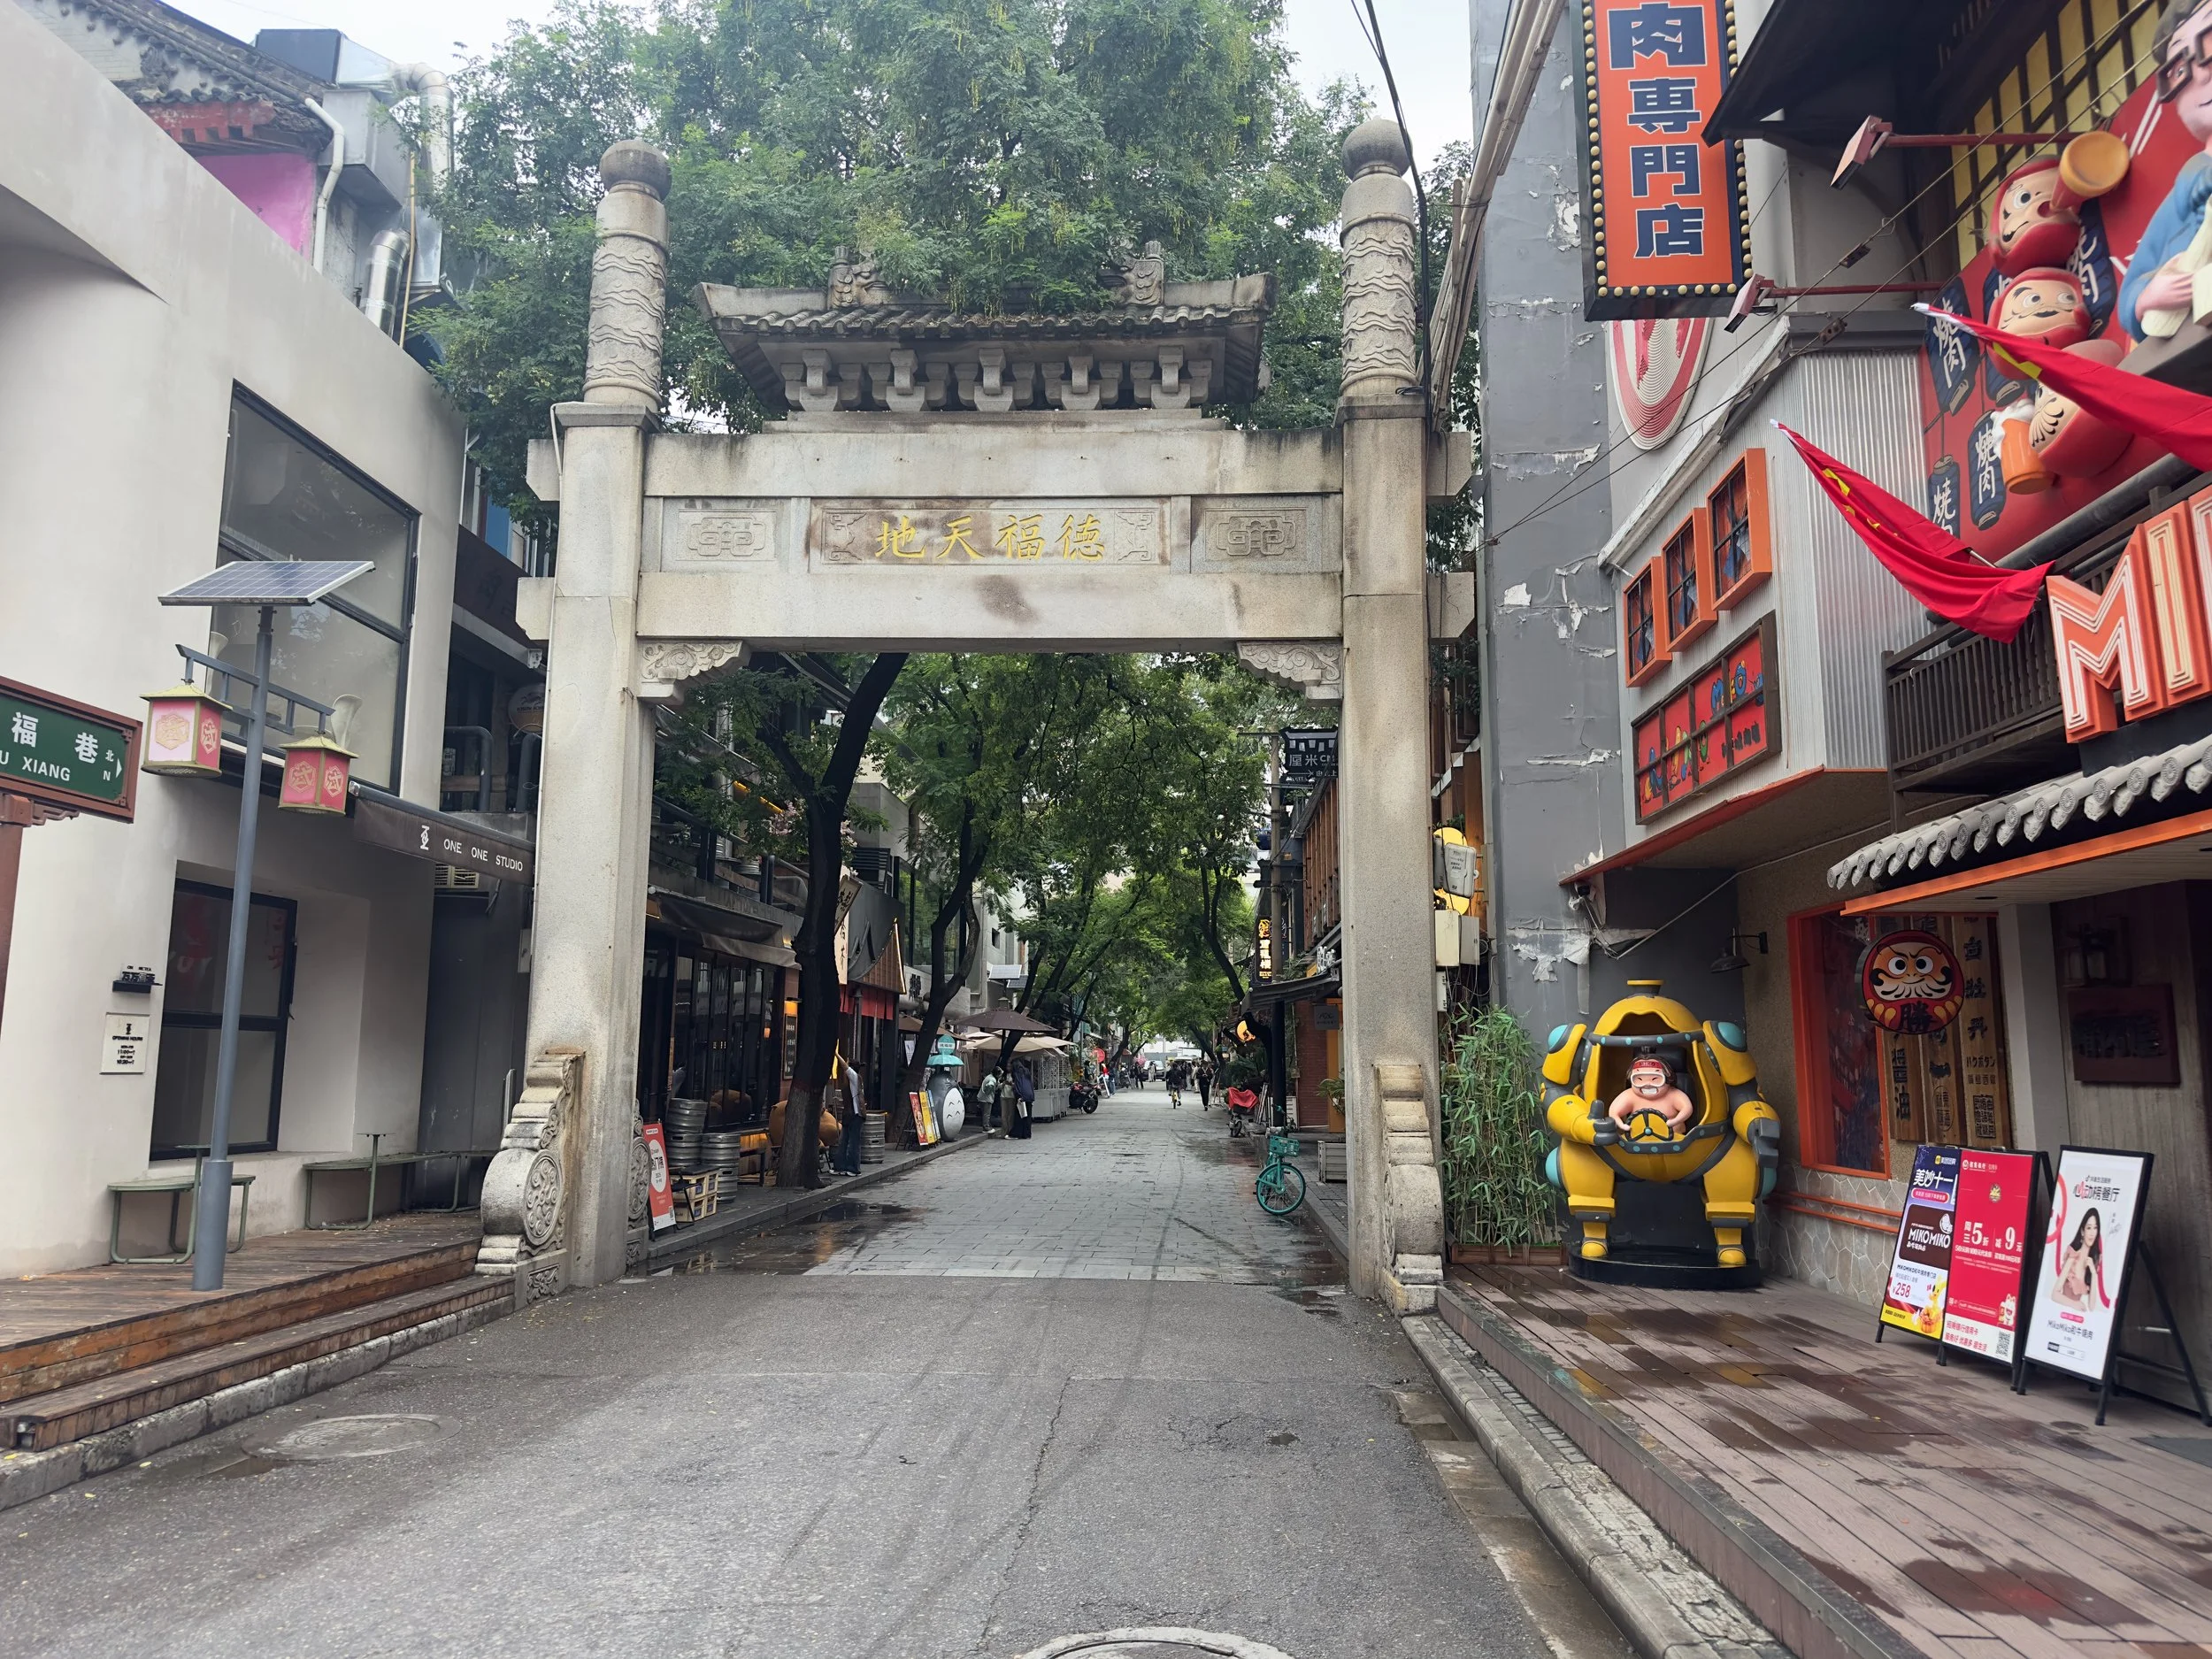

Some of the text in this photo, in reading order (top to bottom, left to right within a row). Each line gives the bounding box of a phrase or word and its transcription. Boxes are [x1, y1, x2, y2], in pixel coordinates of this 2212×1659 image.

[2046, 484, 2212, 743] MI
[104, 749, 115, 762] 北
[22, 757, 71, 781] XIANG
[103, 771, 111, 781] N
[443, 838, 523, 872] ONE ONE STUDIO
